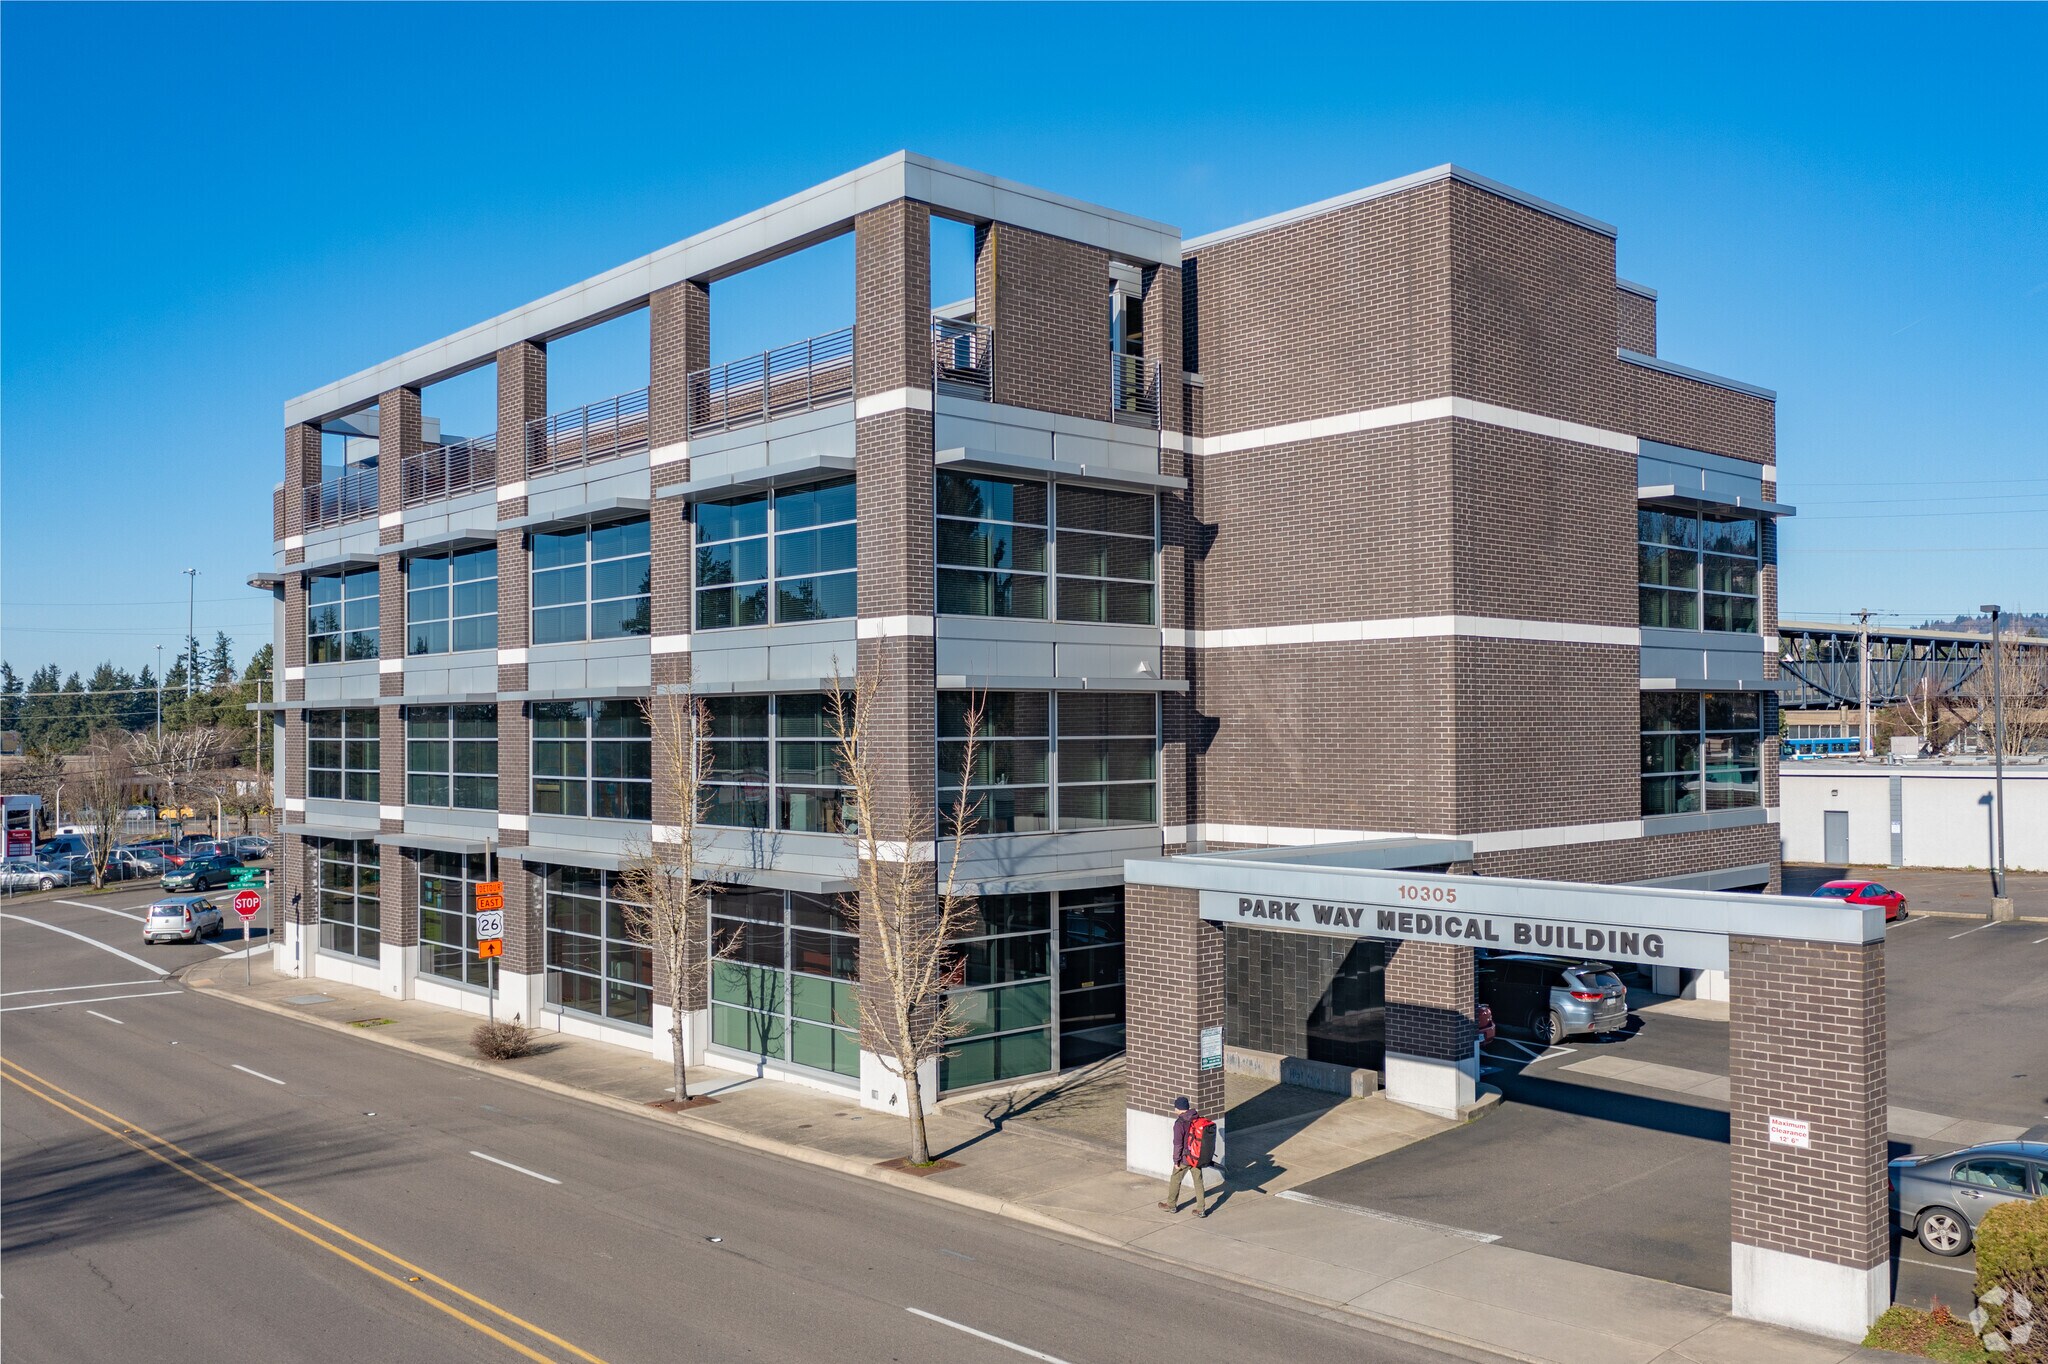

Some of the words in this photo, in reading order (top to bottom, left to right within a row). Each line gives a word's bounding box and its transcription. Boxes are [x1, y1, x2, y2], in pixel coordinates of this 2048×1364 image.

[479, 884, 501, 893] DETOUR
[1398, 885, 1457, 904] 10305
[236, 897, 259, 908] STOP
[480, 899, 499, 908] EAST
[481, 919, 499, 931] 26
[1238, 898, 1301, 922] PARK
[1312, 904, 1364, 928] WAY
[1376, 911, 1500, 942] MEDICAL
[1513, 923, 1665, 958] BUILDING
[1772, 1119, 1806, 1129] Maximum
[1771, 1127, 1807, 1137] Clearance
